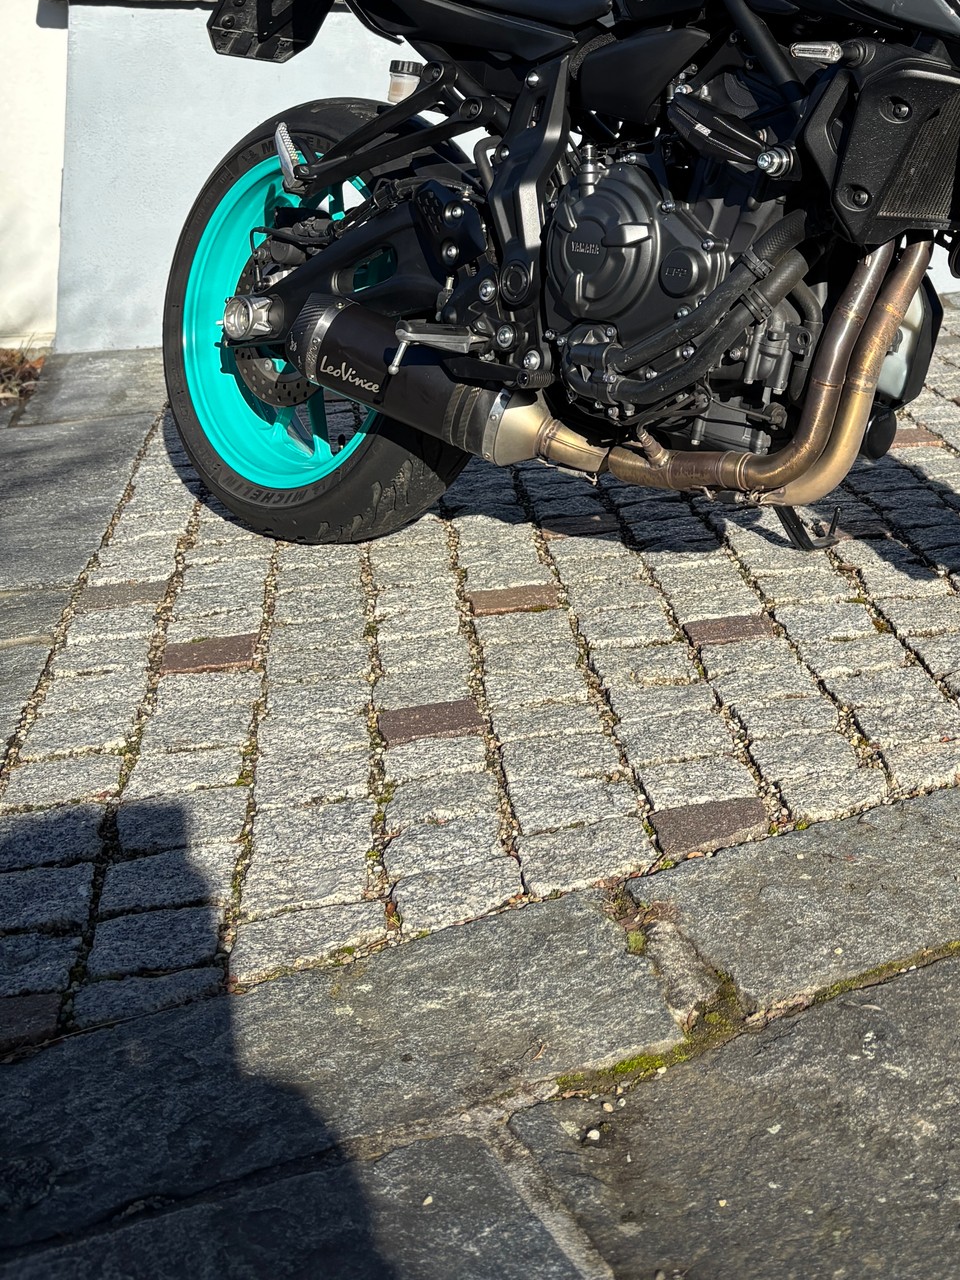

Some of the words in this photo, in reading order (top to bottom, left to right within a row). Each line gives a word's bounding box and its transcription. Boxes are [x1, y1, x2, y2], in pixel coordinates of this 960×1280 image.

[571, 240, 600, 255] YAMAHA
[319, 355, 381, 393] LeoVince
[222, 474, 308, 505] MICHELIN
